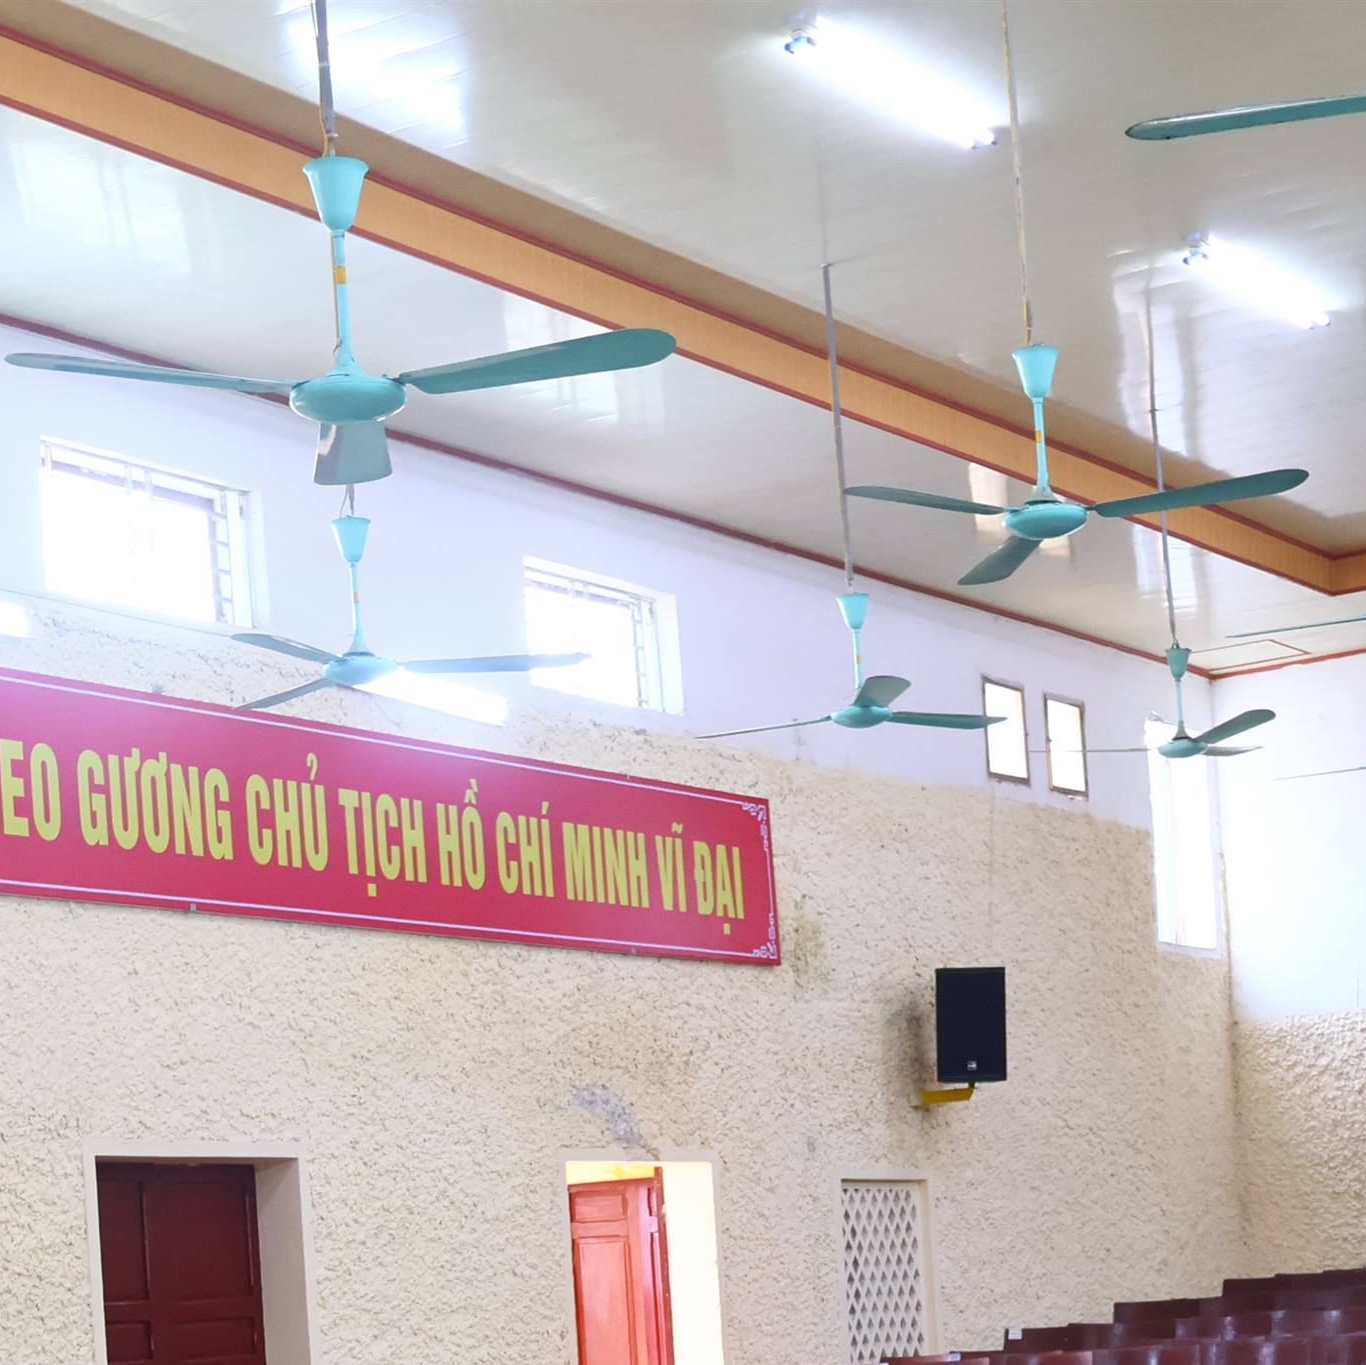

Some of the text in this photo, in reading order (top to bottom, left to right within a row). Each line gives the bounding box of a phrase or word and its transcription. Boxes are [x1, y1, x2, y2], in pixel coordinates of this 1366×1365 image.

[78, 747, 235, 861] GƯƠNG
[246, 752, 330, 872] CHỦ
[338, 789, 428, 898] TỊCH
[436, 778, 486, 890] HỒ
[496, 800, 555, 897] CHÍ
[562, 822, 650, 908] MINH
[655, 821, 688, 913] VĨ
[693, 841, 745, 934] ĐẠI
